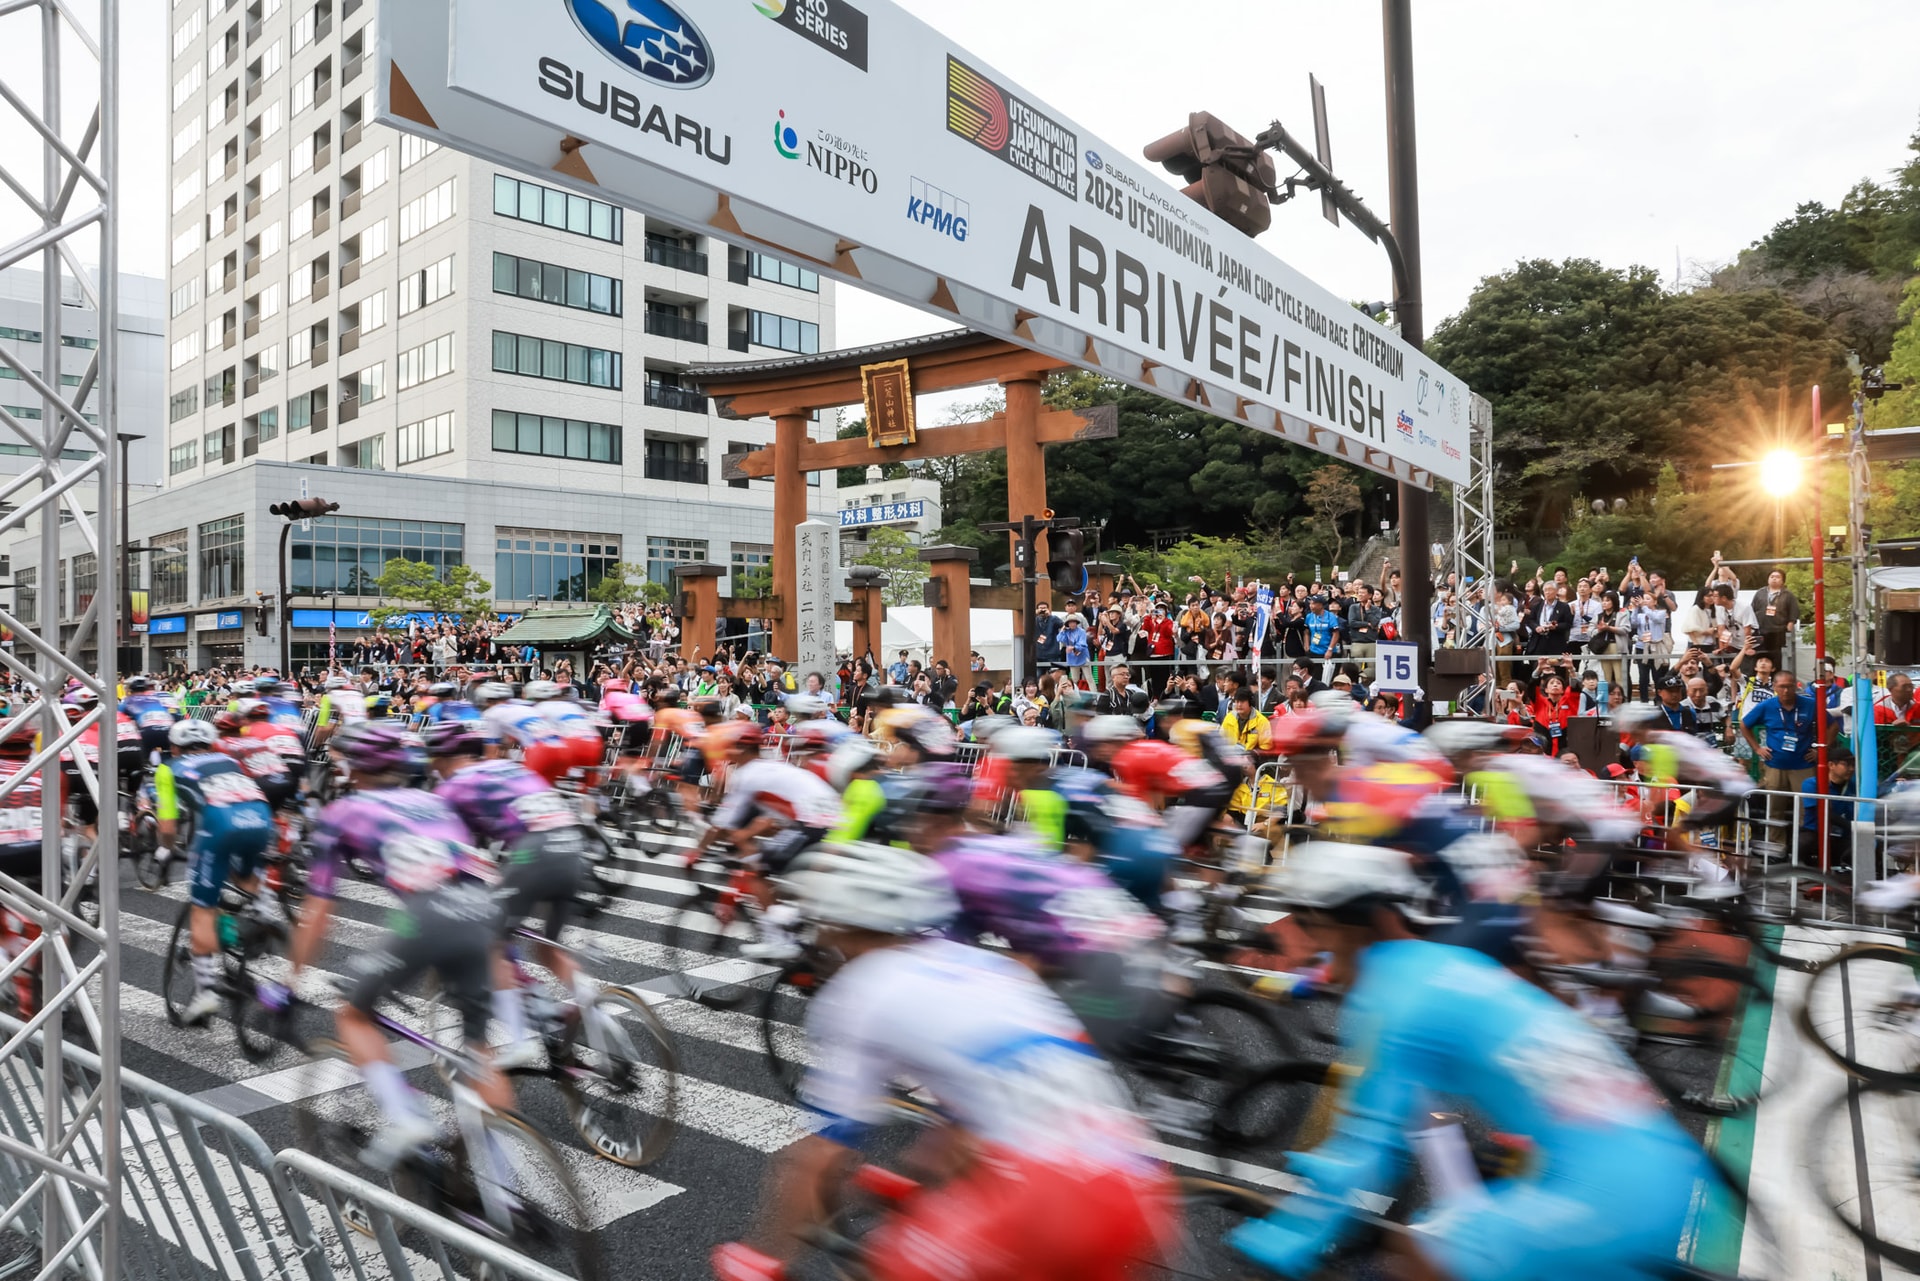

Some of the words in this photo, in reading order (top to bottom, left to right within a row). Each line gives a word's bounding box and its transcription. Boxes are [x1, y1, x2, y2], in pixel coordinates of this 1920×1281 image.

[795, 5, 848, 50] SERIES
[538, 56, 731, 166] SUBARU
[1009, 98, 1075, 156] UTSUNOMIYA
[806, 140, 878, 194] NIPPO
[817, 128, 869, 162] この道の先に
[1009, 147, 1034, 169] CYCLE
[1035, 162, 1056, 183] ROAD
[1057, 173, 1076, 197] RACE
[1010, 122, 1050, 166] JAPAN
[1052, 147, 1075, 180] CUP
[906, 195, 968, 242] KPMG
[1104, 163, 1140, 193] SUBARU
[1142, 186, 1188, 224] LAYBACK
[1189, 217, 1210, 236] presents
[1085, 169, 1124, 221] 2025
[1128, 195, 1214, 273] UTSUNOMIYA
[1217, 251, 1252, 295] JAPAN
[1254, 273, 1274, 307] CUP
[1275, 286, 1303, 325] CYCLE
[1304, 304, 1327, 339] ROAD
[1328, 318, 1349, 351] RACE
[1352, 322, 1404, 382] CRITERIUM
[1011, 203, 1386, 444] ARRIVÉE/FINISH
[871, 502, 921, 521] 整形外科
[1383, 654, 1411, 680] 15
